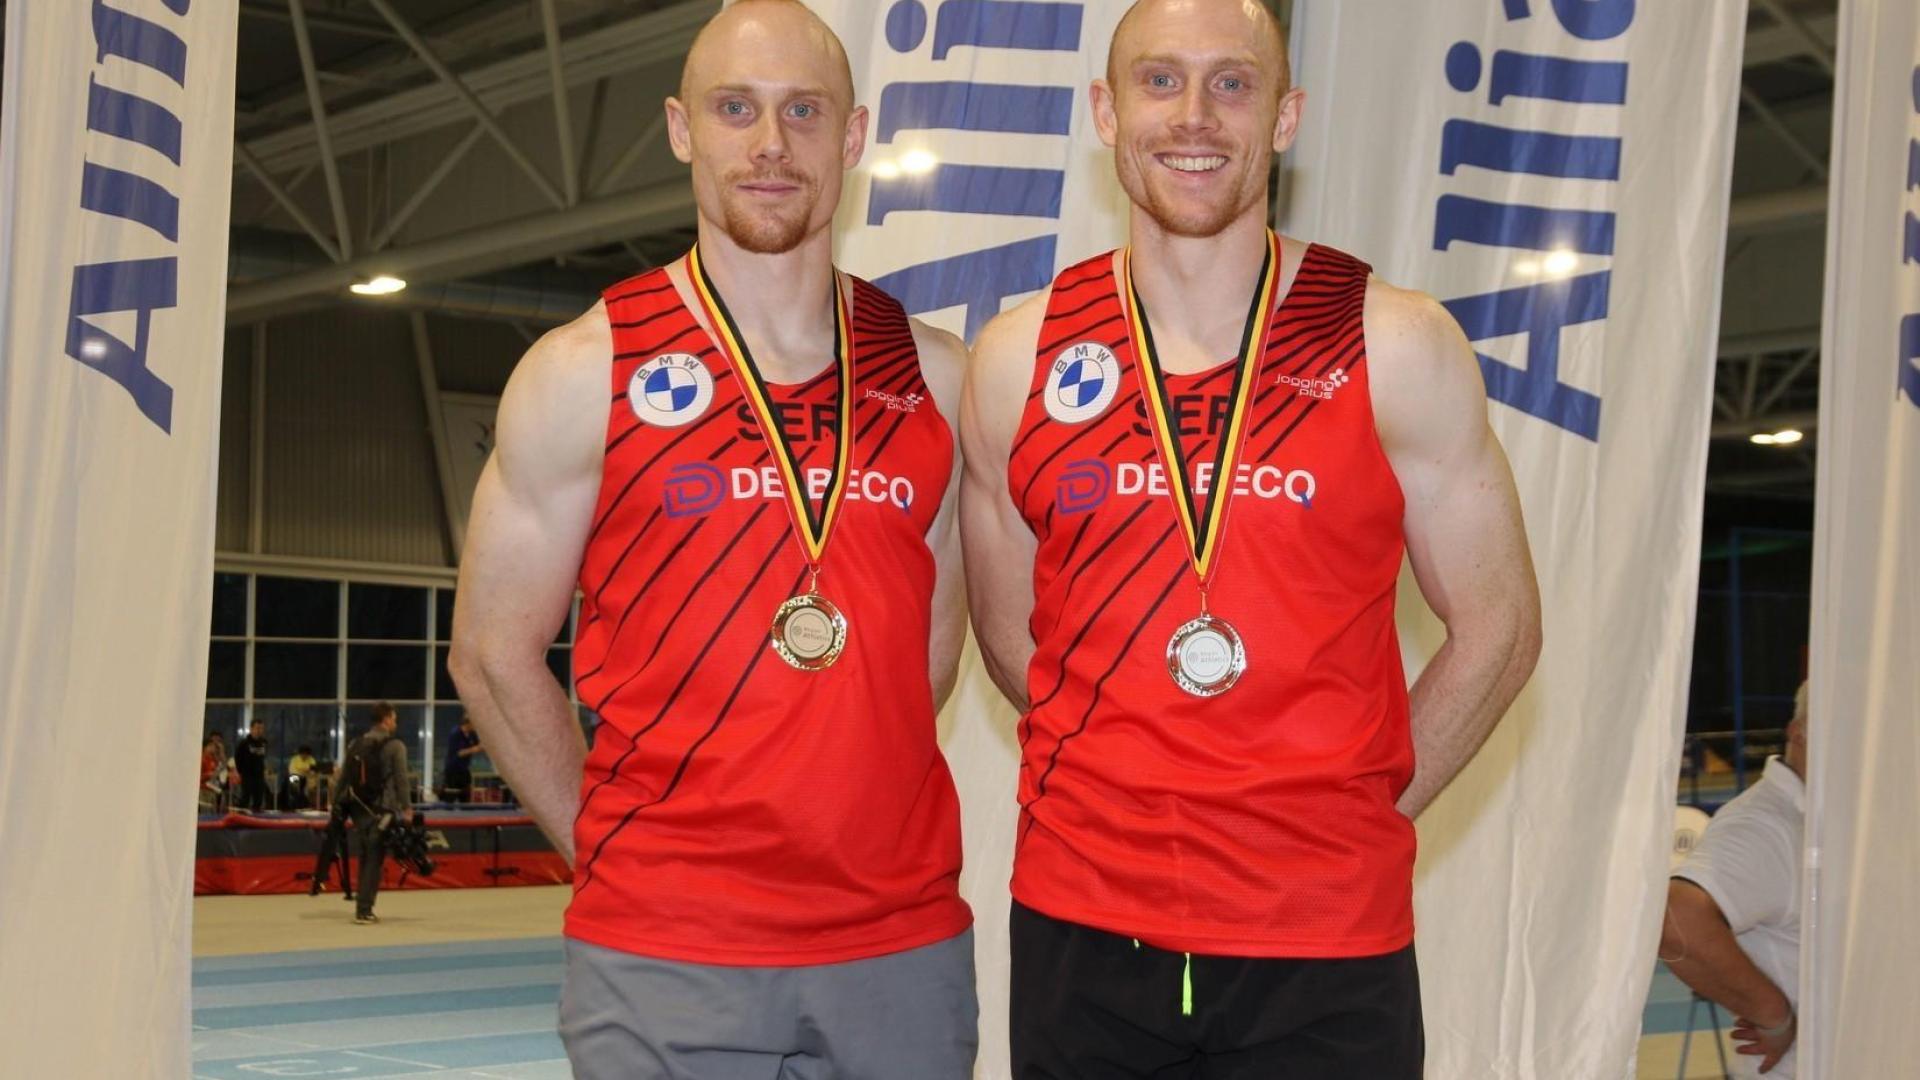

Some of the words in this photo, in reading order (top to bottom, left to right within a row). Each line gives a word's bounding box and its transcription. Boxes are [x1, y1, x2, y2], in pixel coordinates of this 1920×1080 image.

[65, 0, 190, 435] Alli
[637, 355, 699, 381] BMW
[1055, 345, 1110, 374] BMW
[1274, 373, 1334, 392] jogging
[1299, 388, 1332, 399] plus
[864, 386, 914, 407] jogging
[731, 466, 914, 513] DEBECQ
